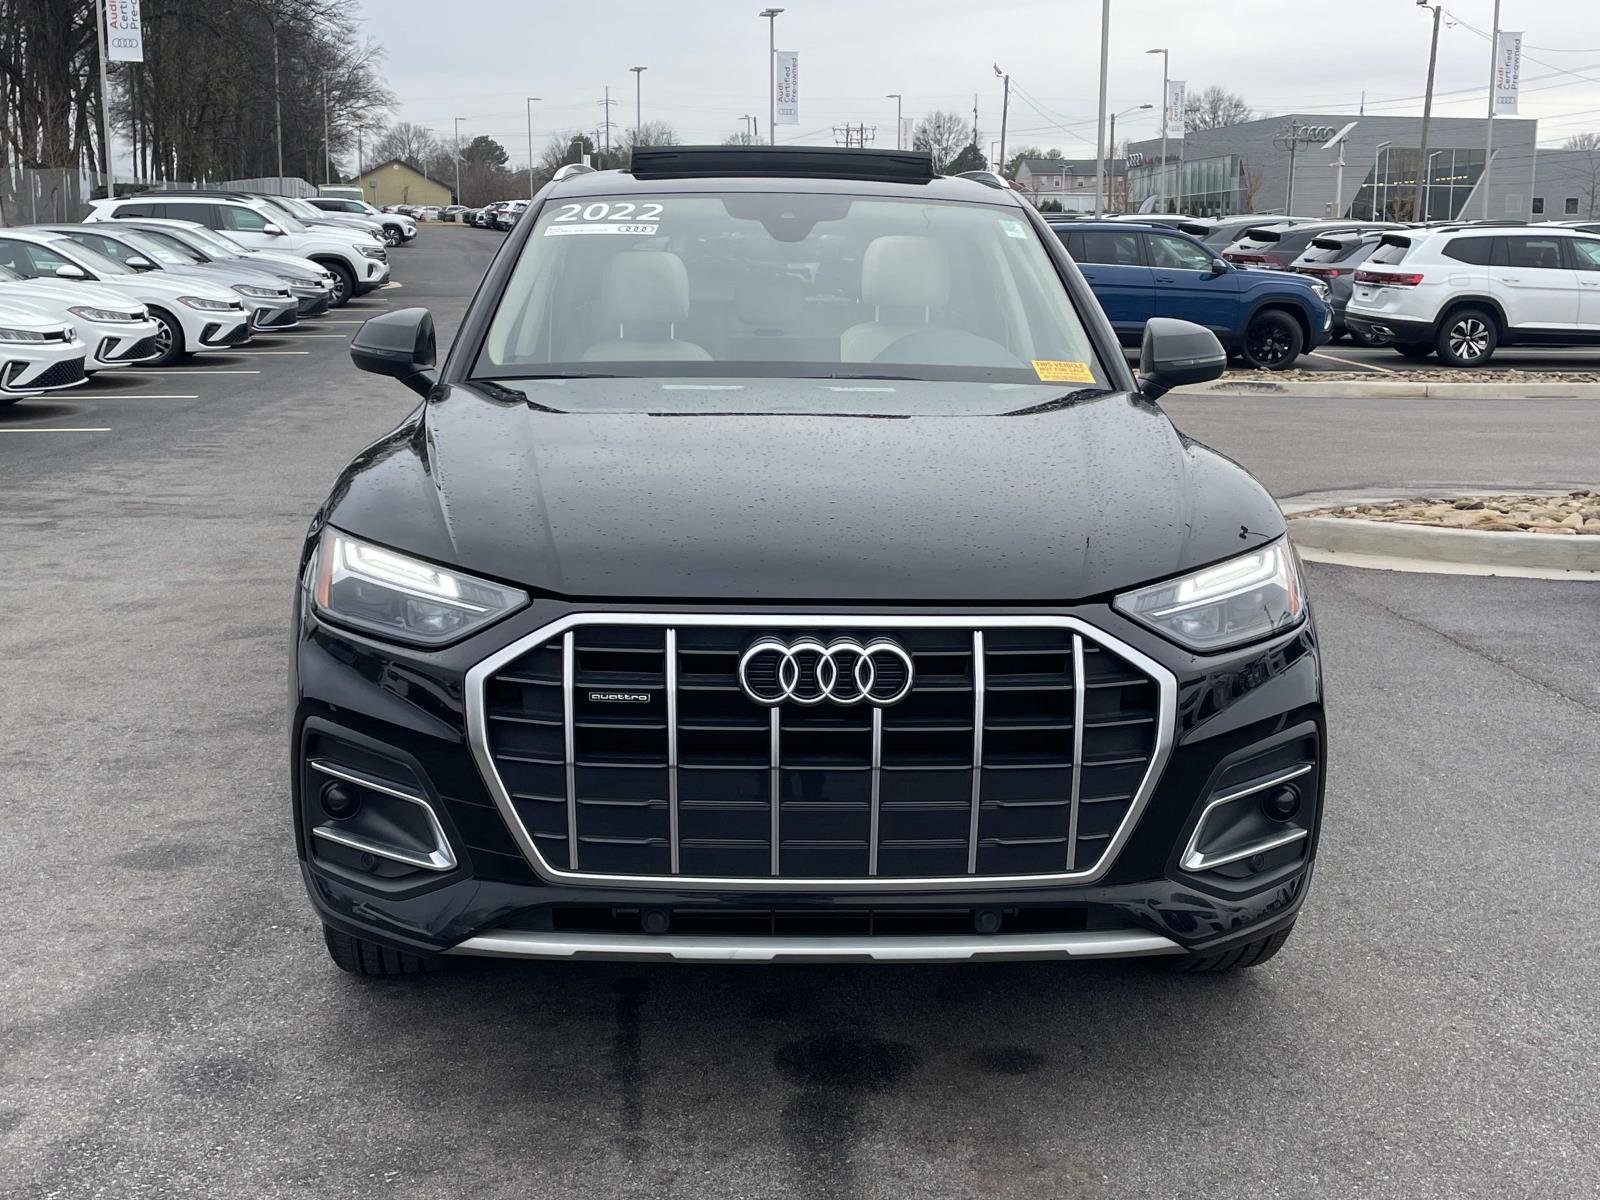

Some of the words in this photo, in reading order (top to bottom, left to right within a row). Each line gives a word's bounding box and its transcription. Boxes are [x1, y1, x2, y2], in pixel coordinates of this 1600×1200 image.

[109, 0, 118, 29] Audi
[1504, 49, 1512, 90] Certified
[1511, 38, 1521, 90] Pre-owned
[554, 203, 664, 222] 2022
